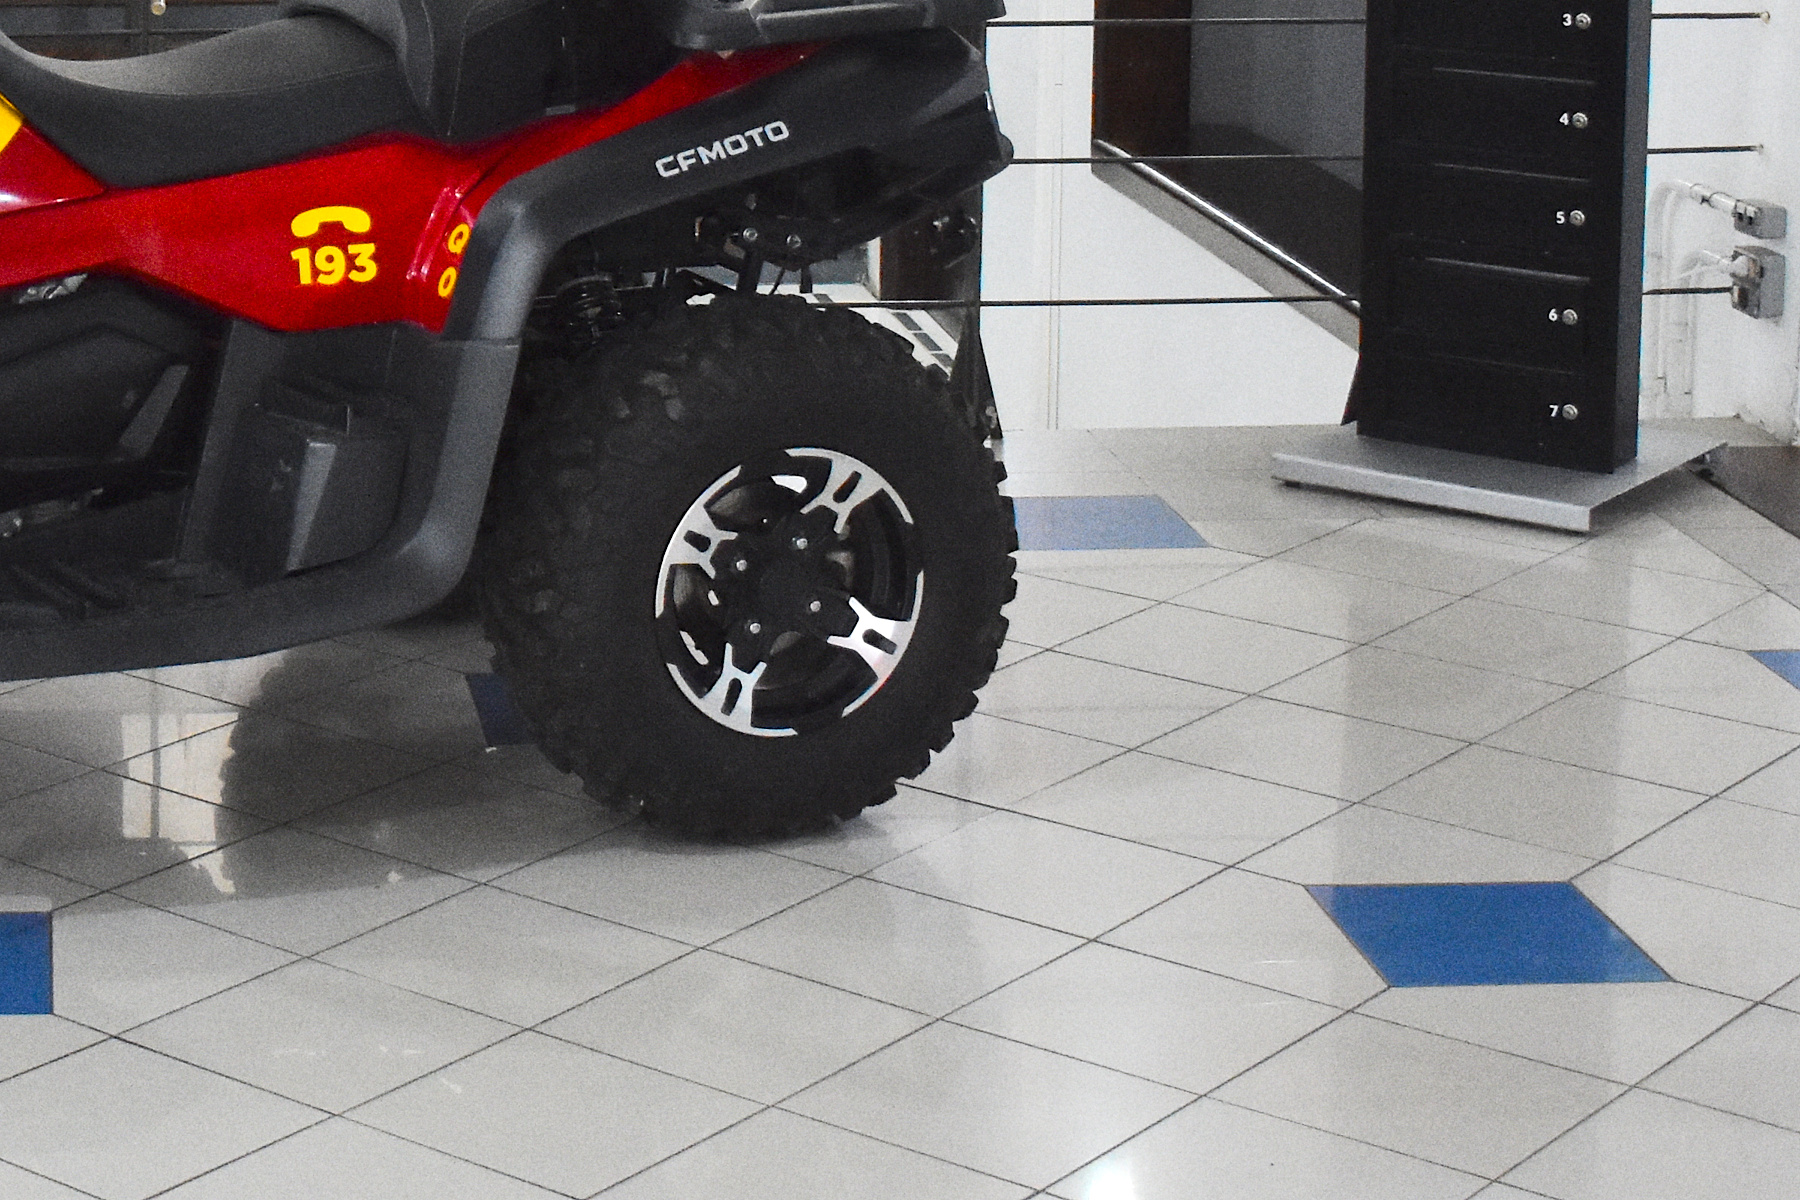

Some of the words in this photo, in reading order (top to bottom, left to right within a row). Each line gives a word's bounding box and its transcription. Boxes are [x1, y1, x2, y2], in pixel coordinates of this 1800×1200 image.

[1562, 13, 1572, 27] 3
[1559, 112, 1569, 126] 4
[655, 120, 789, 178] CFMOTO
[1556, 211, 1565, 224] 5
[290, 243, 377, 285] 193
[1548, 308, 1558, 322] 6
[1549, 405, 1559, 417] 7
